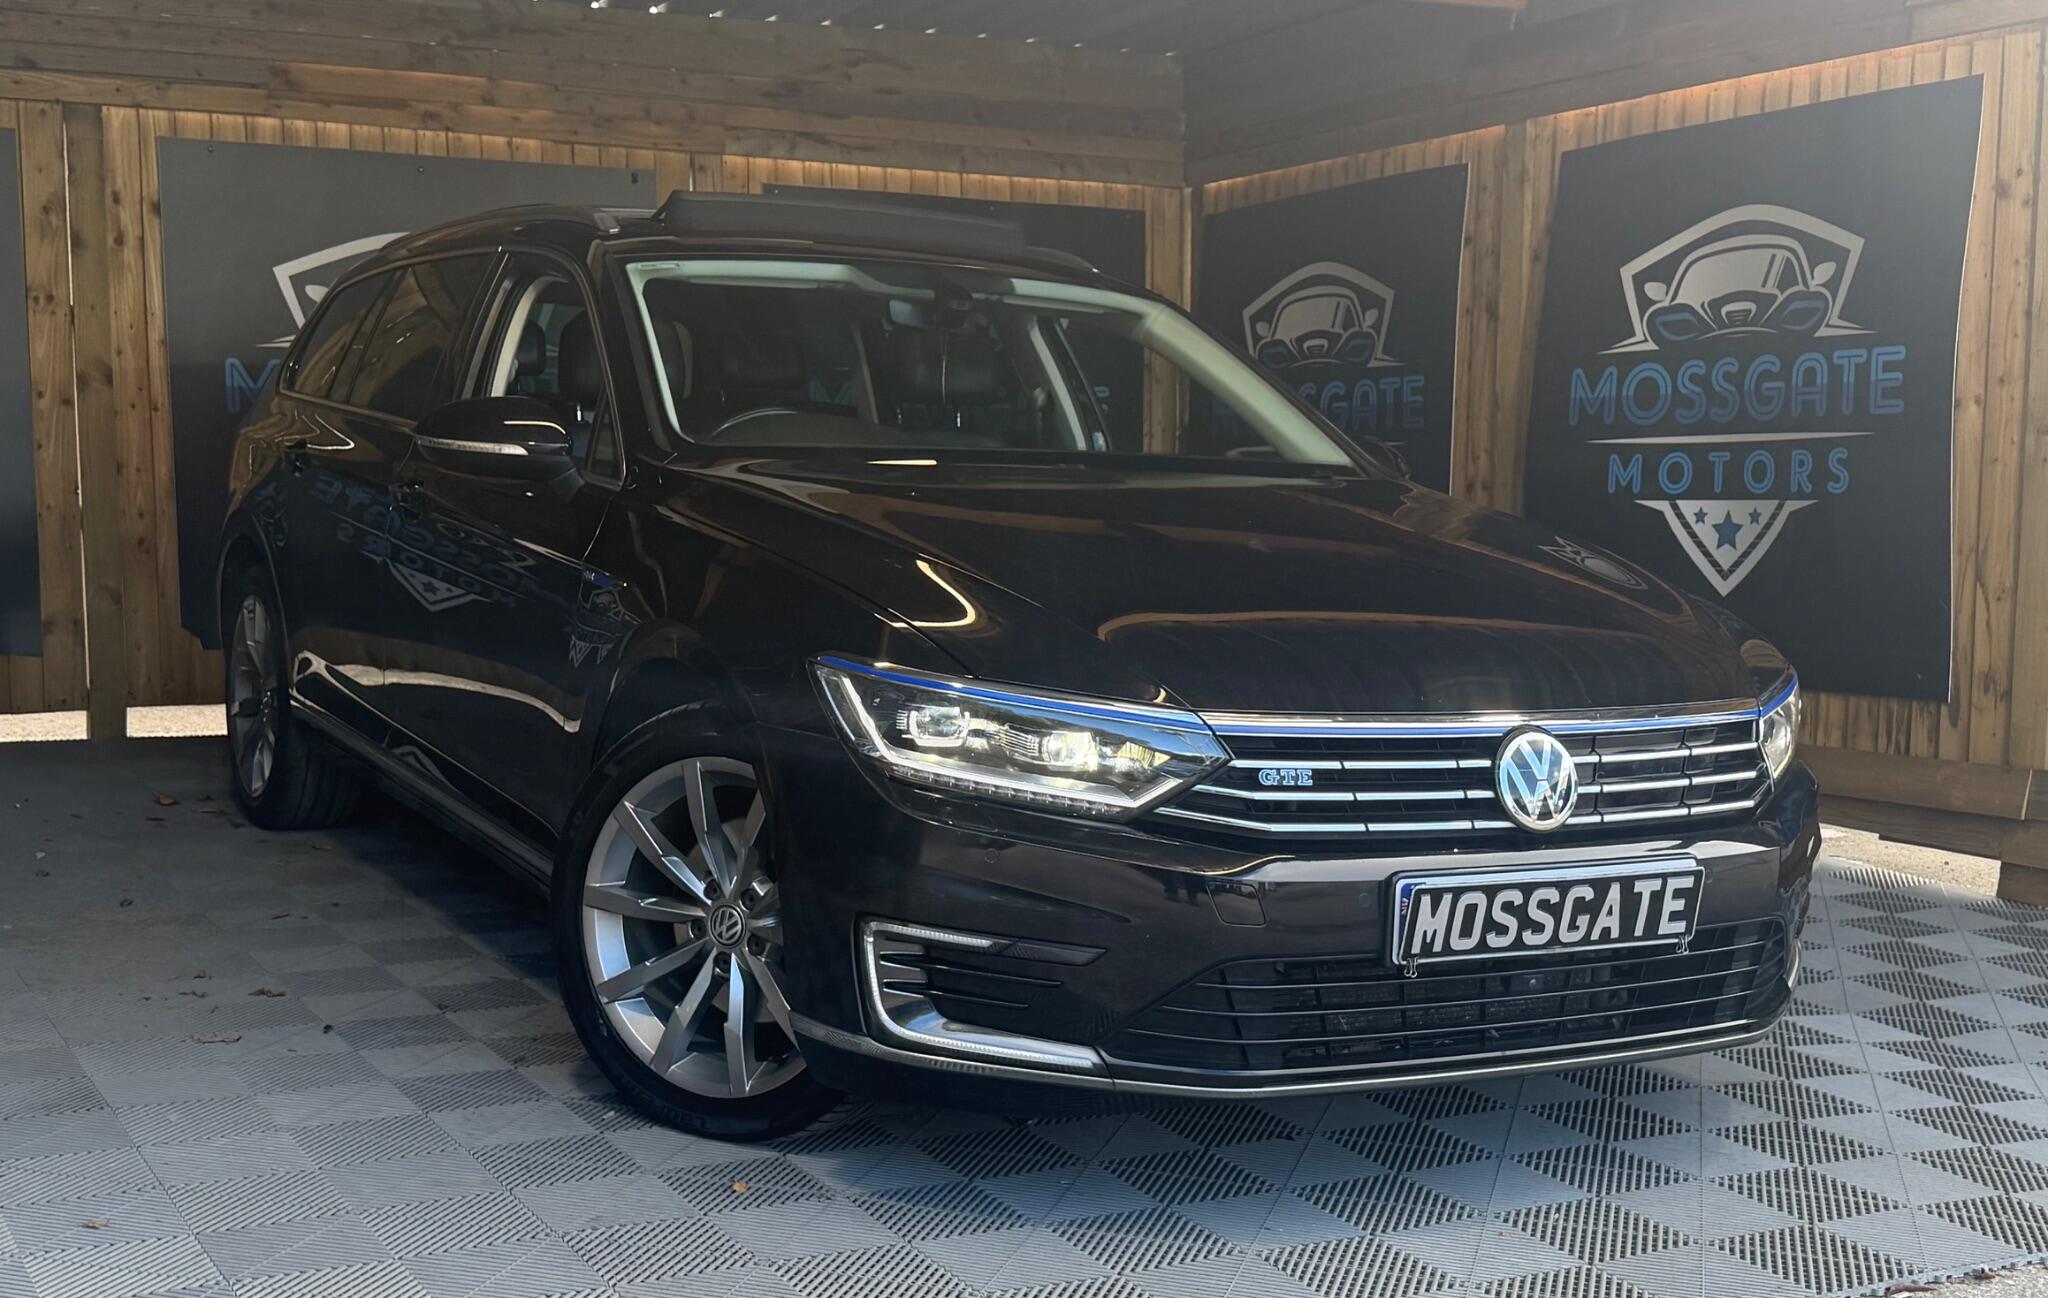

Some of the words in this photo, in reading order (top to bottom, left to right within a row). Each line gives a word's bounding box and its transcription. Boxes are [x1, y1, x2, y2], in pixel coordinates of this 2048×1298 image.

[1568, 345, 1906, 426] MOSSGATE
[1606, 448, 1850, 494] MOTORS
[1258, 769, 1314, 786] GTE
[1411, 875, 1695, 955] MOSSGATE
